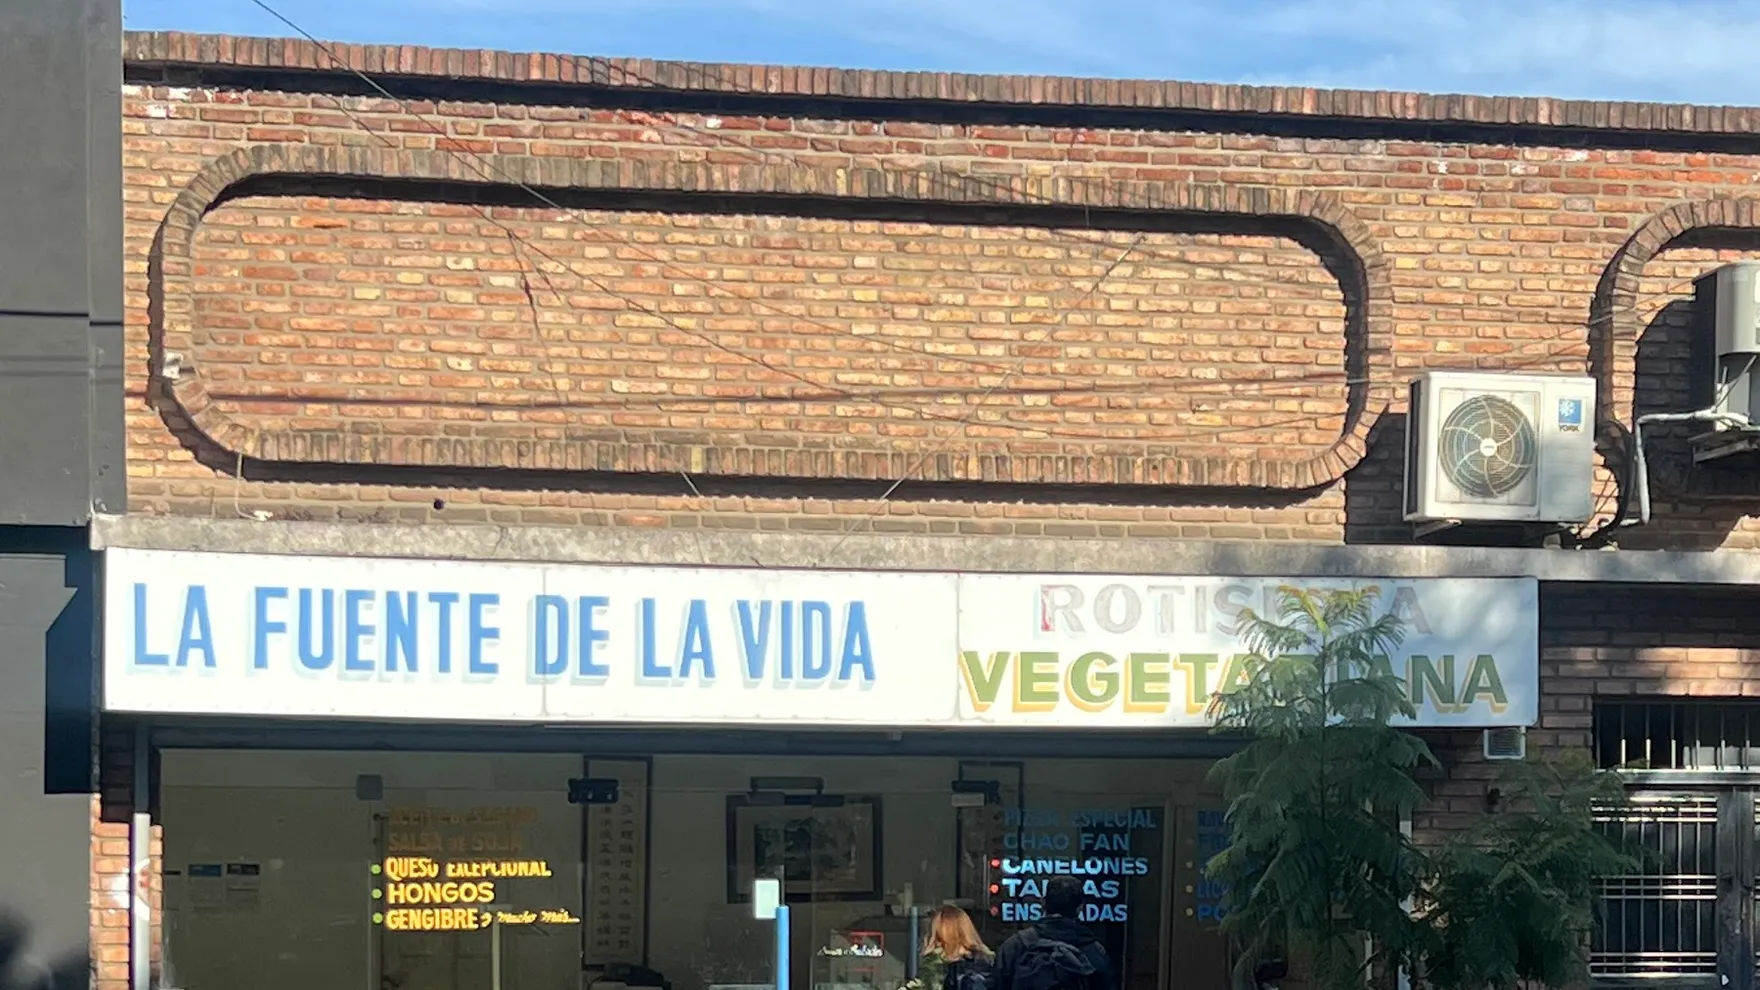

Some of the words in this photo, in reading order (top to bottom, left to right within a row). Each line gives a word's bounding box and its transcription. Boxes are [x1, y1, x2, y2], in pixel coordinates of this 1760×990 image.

[1557, 424, 1580, 432] YORK
[1038, 583, 1433, 637] ROTISA
[132, 582, 218, 672] LA
[251, 586, 500, 677] FUENTE
[532, 593, 610, 680] DE
[640, 597, 716, 682] LA
[735, 599, 877, 685] VIDA
[961, 651, 1508, 709] VEGETAIANA
[1072, 809, 1156, 828] ESPECIAL
[1003, 832, 1070, 850] CHAO
[1080, 832, 1130, 850] FAN
[385, 857, 440, 881] QUESO
[1001, 856, 1149, 875] CANELONES
[386, 882, 495, 904] HONGOS
[1001, 878, 1120, 899] TAAS
[385, 907, 479, 930] GENGIBRE
[1001, 902, 1128, 922] ENSDAS
